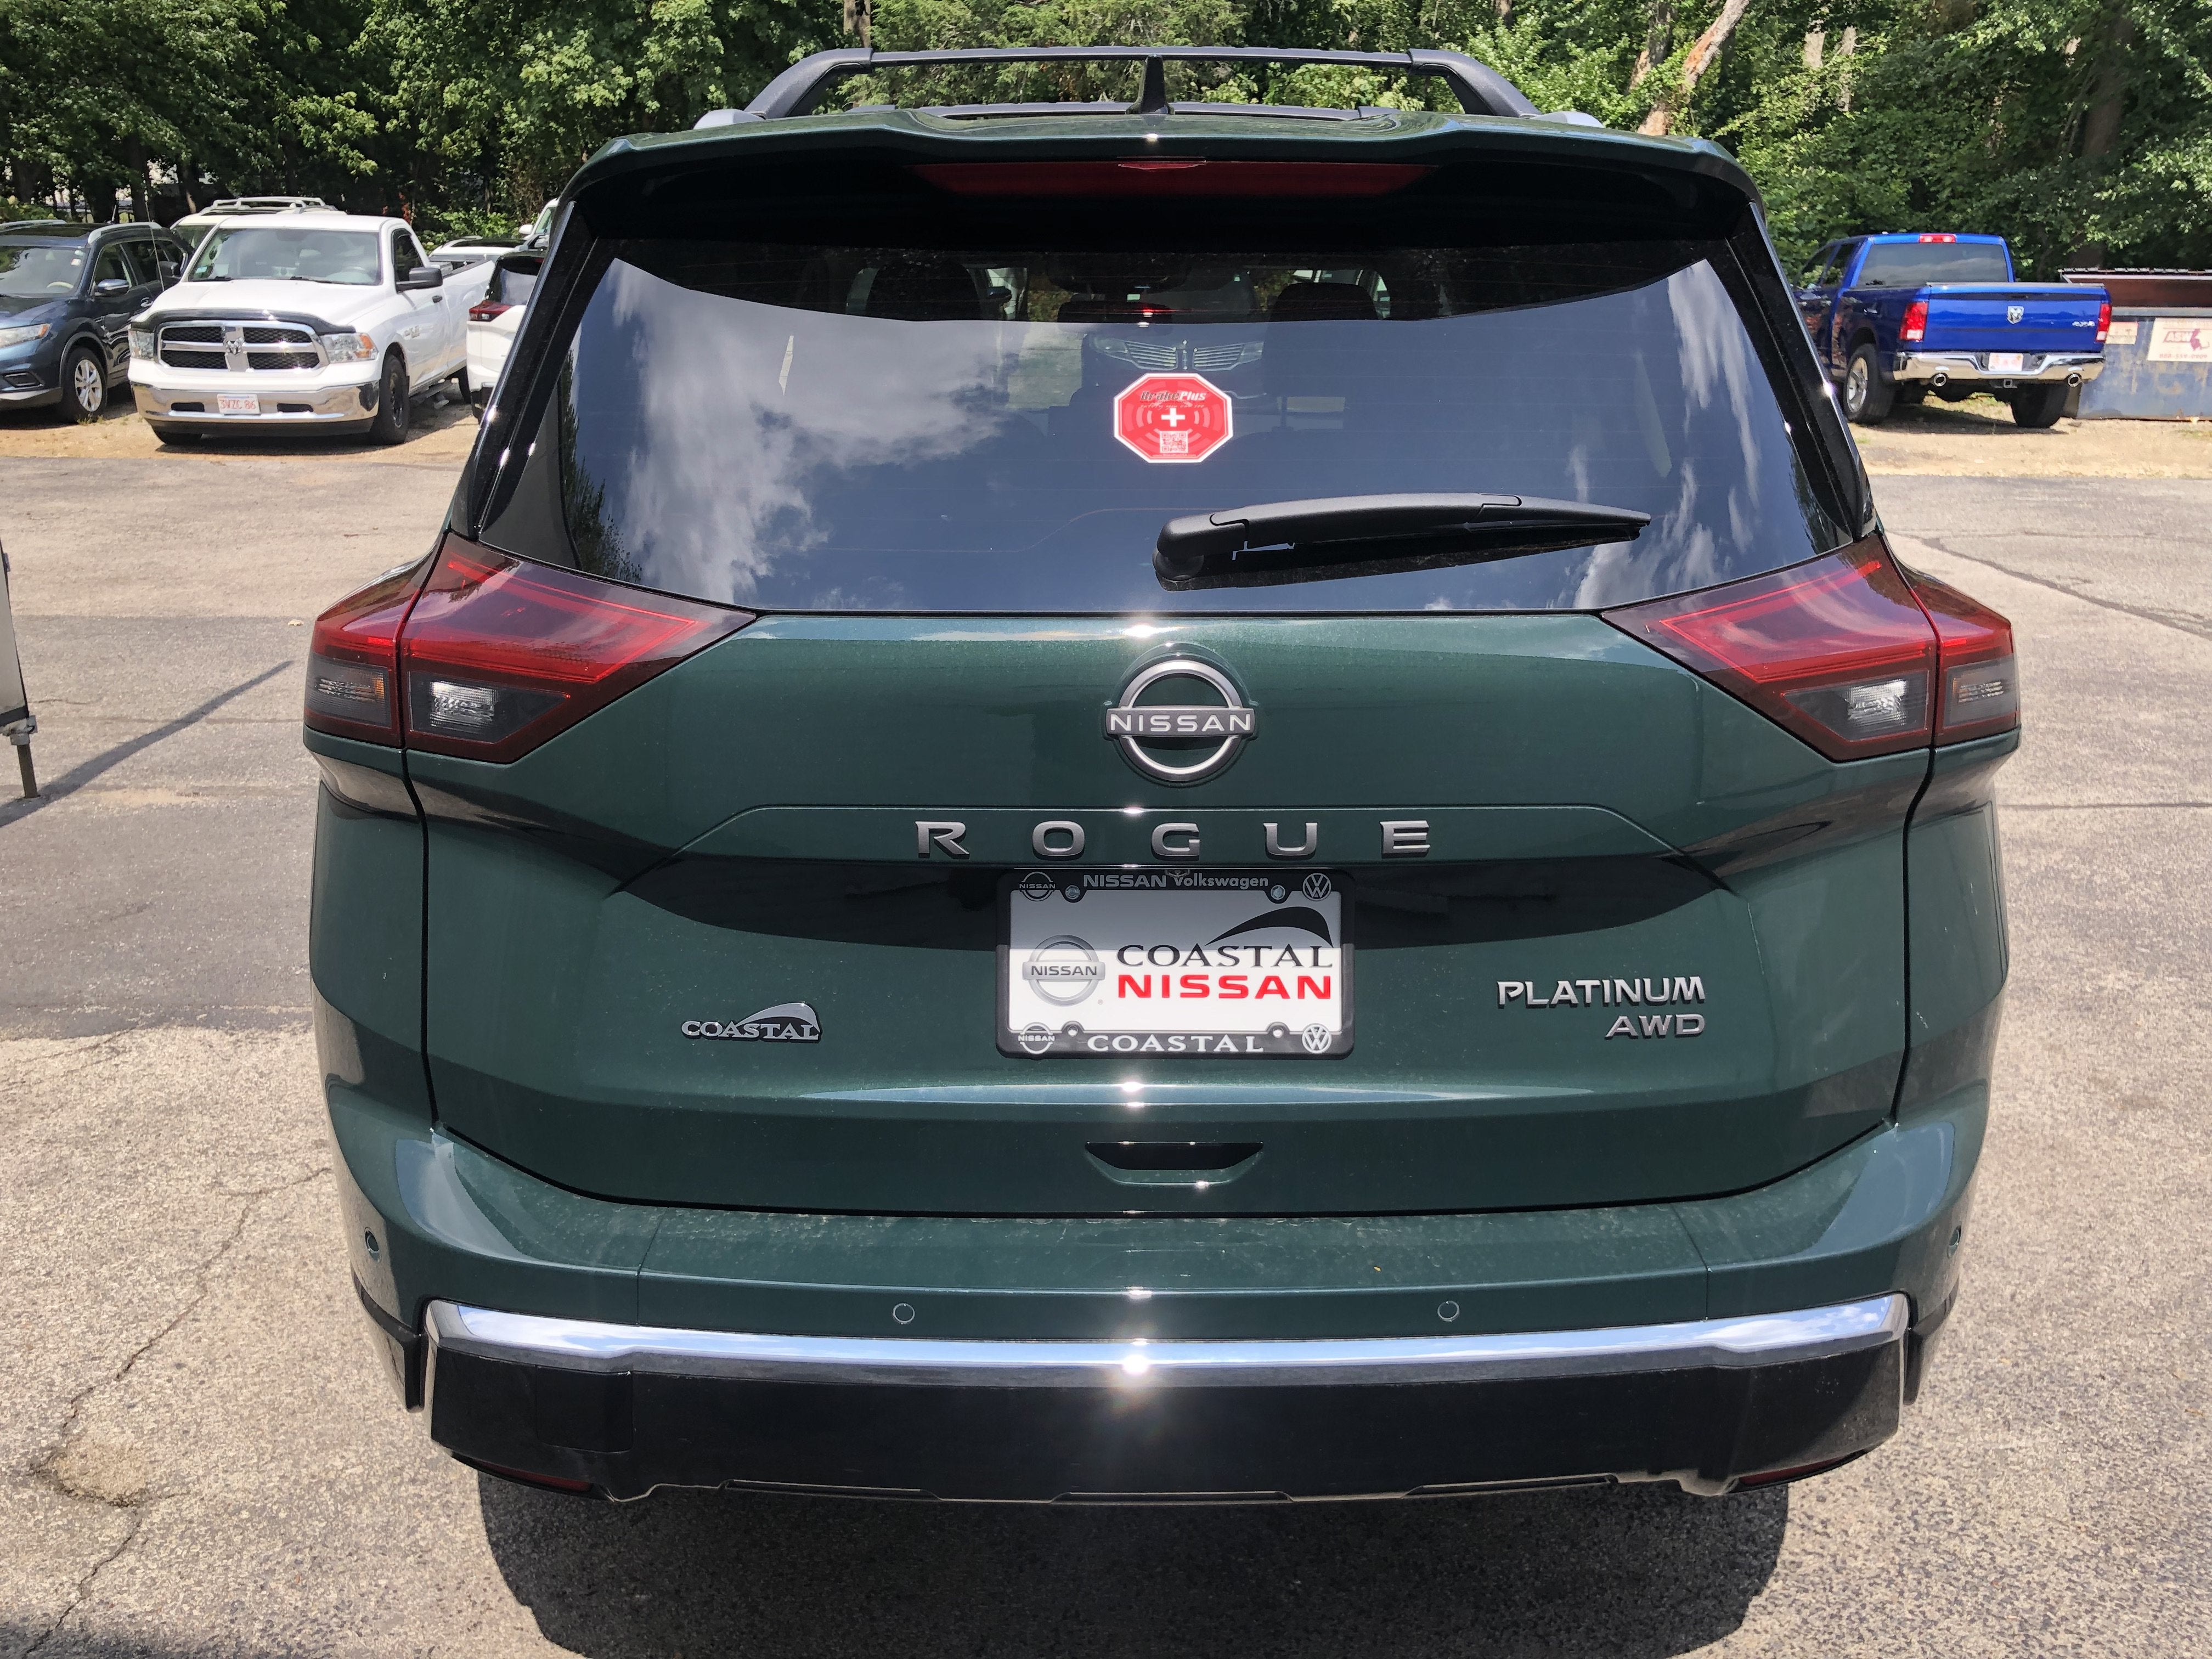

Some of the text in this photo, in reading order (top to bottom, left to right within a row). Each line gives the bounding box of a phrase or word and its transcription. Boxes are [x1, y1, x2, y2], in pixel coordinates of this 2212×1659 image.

[1141, 391, 1206, 400] BrakePlus
[1110, 714, 1251, 732] NISSAN
[915, 820, 1430, 858] ROGUE
[1083, 872, 1268, 890] NISSAN Volkswagen
[1116, 943, 1333, 968] COASTAL
[1030, 965, 1098, 976] NISSAN
[1118, 974, 1331, 999] NISSAN
[1497, 976, 1706, 1006] PLATINUM
[681, 1020, 820, 1041] COASTAL
[1604, 1013, 1706, 1039] AWD
[1087, 1034, 1264, 1053] COASTAL
